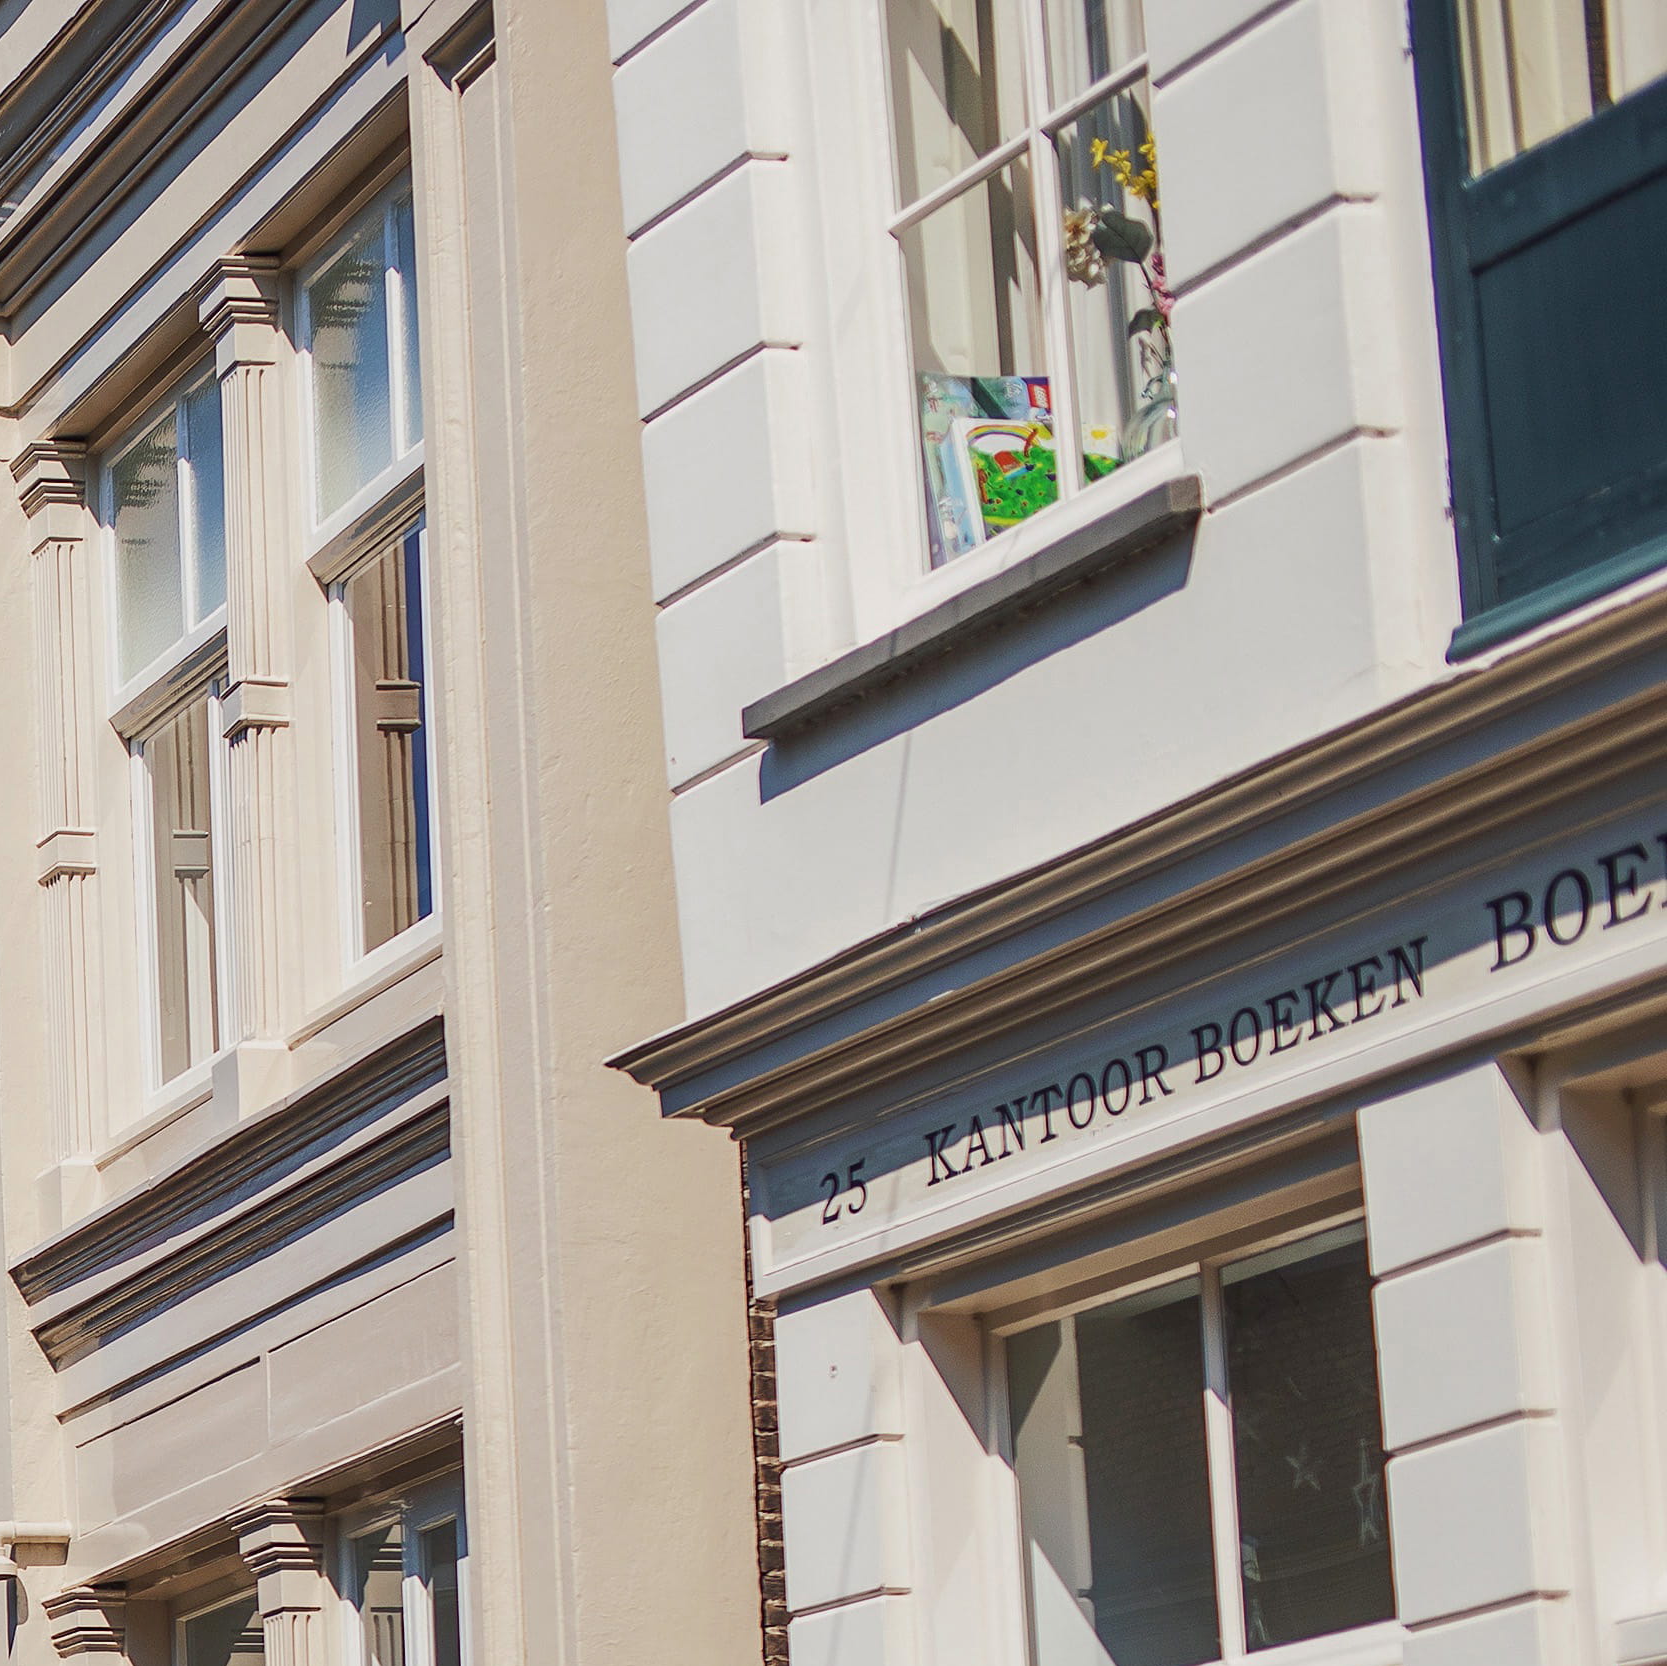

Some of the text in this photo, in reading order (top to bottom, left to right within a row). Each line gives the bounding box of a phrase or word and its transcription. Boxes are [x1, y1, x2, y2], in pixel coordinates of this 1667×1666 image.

[820, 1159, 868, 1225] 25
[924, 1044, 1175, 1188] KANTOOR
[1190, 936, 1429, 1085] BOEKEN
